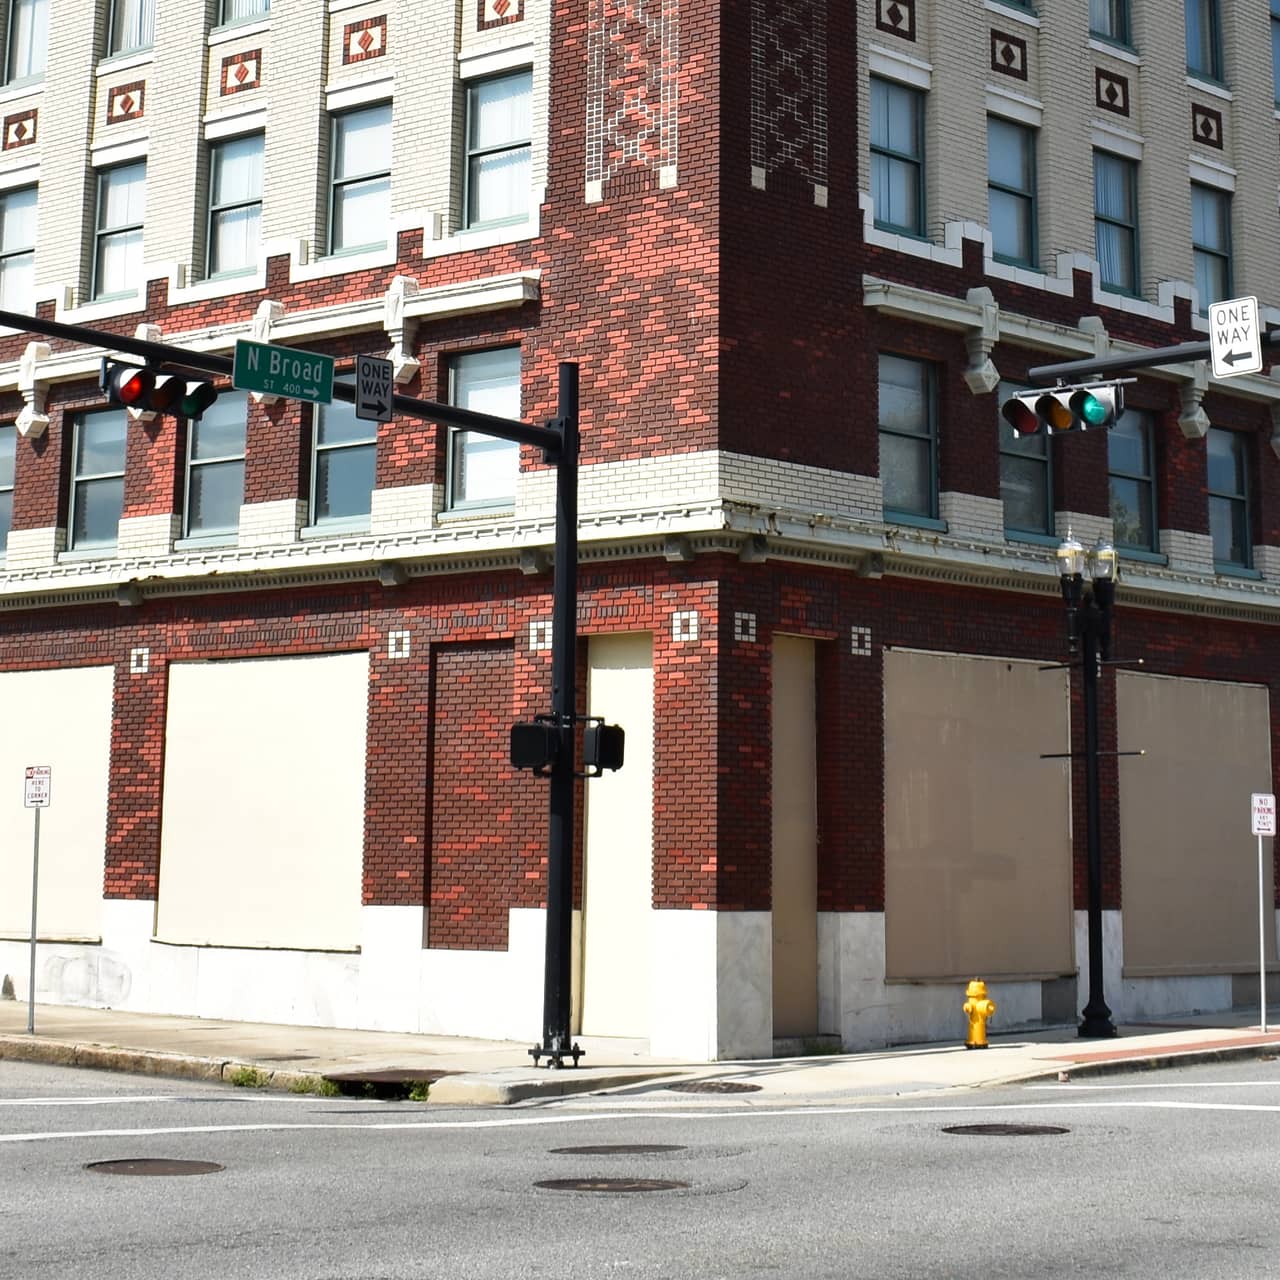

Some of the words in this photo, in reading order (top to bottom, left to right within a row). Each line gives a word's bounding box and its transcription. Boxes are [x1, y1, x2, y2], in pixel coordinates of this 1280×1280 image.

[1216, 305, 1250, 325] ONE
[1217, 325, 1250, 346] WAY
[247, 346, 260, 372] N
[270, 350, 324, 383] Broad
[361, 362, 390, 381] ONE
[263, 380, 275, 390] ST
[282, 383, 301, 395] 400
[361, 380, 390, 399] WAY
